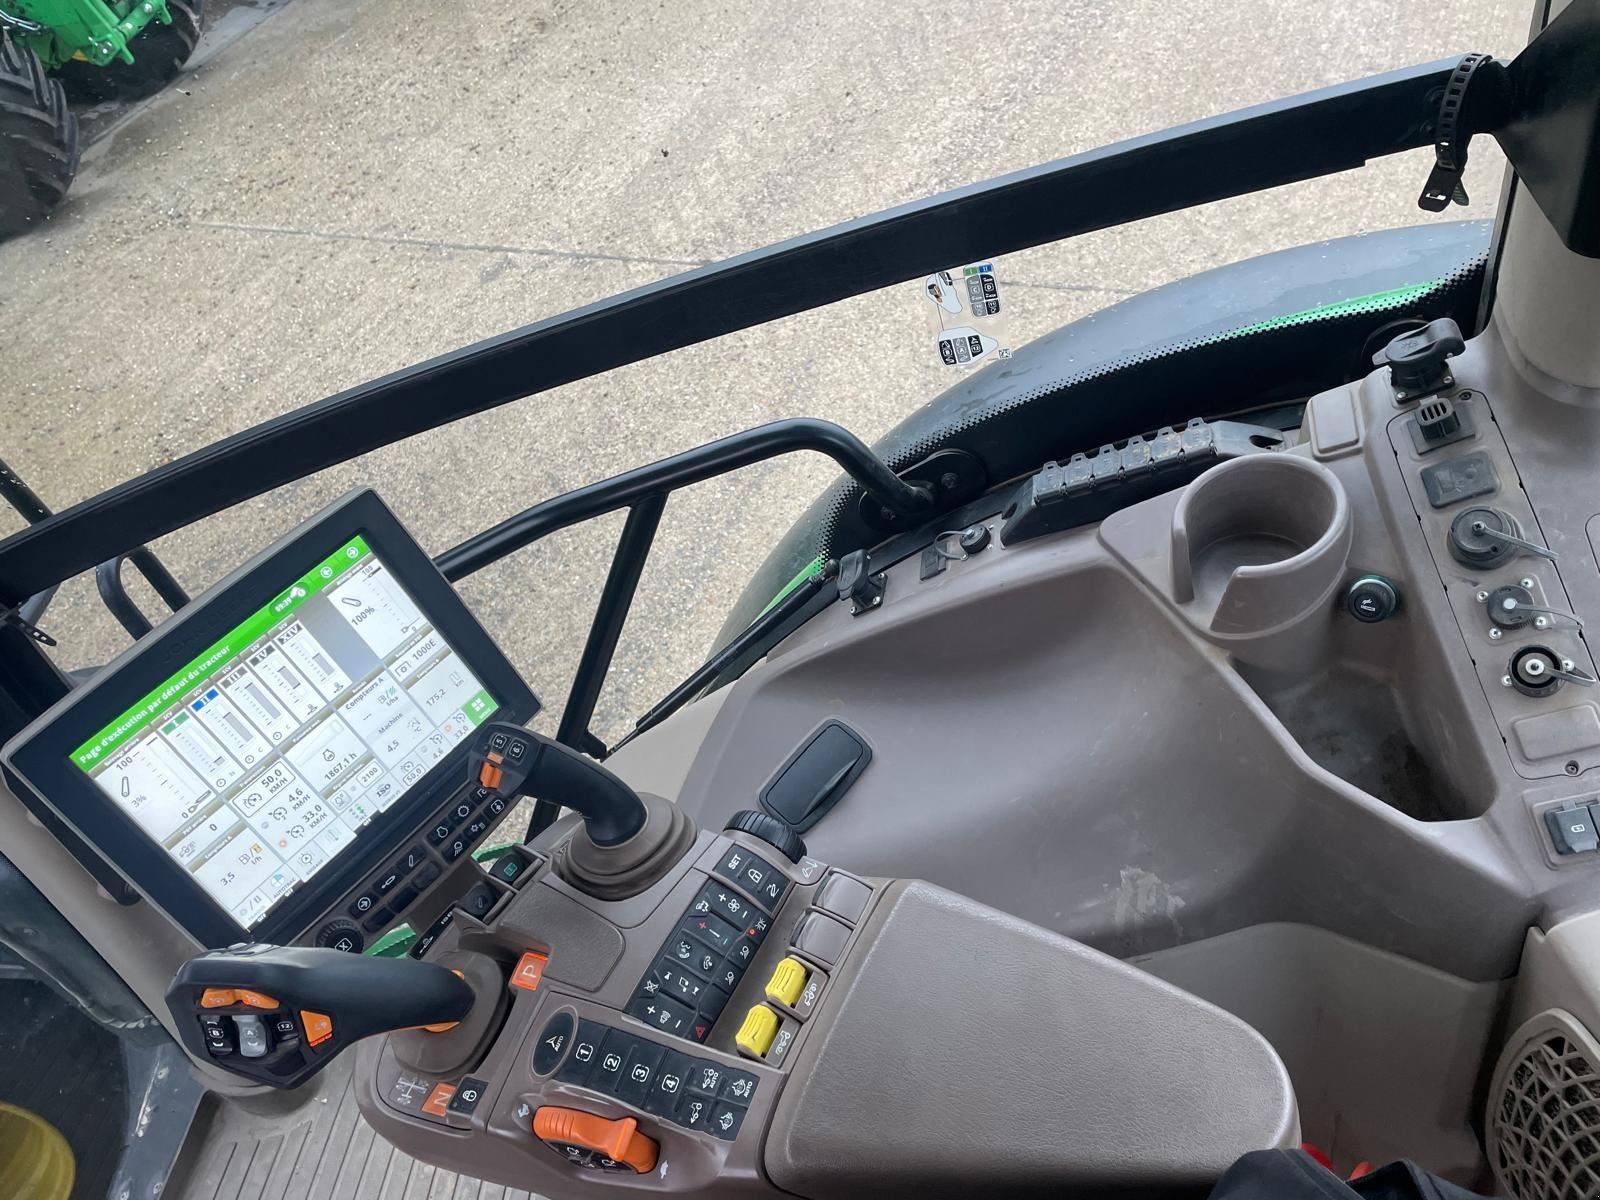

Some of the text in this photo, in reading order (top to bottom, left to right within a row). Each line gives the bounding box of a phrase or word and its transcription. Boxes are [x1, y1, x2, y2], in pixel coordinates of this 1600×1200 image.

[350, 604, 375, 626] 100%
[279, 624, 300, 642] XIV
[255, 649, 269, 661] IV
[411, 638, 436, 661] 1000E
[226, 670, 241, 684] III
[199, 694, 211, 705] II
[344, 681, 379, 710] Compteurs
[425, 688, 446, 707] 175,2
[78, 644, 231, 764] Page d'exécution par défaut du tracteur
[377, 711, 403, 734] Machine
[453, 724, 469, 739] 33,0
[385, 739, 400, 753] 4,5
[115, 755, 134, 771] 100
[324, 757, 350, 781] 1867,1
[348, 751, 357, 759] h
[260, 768, 283, 788] 50,0
[361, 766, 378, 782] 2100
[406, 767, 422, 783] 50,0
[268, 776, 288, 793] KM/H
[375, 782, 392, 797] ISO
[130, 793, 147, 808] 3%
[286, 787, 304, 803] 4,6
[291, 793, 311, 811] KM/H
[180, 811, 189, 819] 0
[301, 803, 323, 823] 33,0
[308, 811, 327, 829] KM/H
[208, 822, 218, 831] 0
[728, 853, 741, 870] SET
[219, 871, 237, 887] 3,5
[522, 964, 536, 978] P
[607, 1057, 619, 1067] 2
[635, 1068, 647, 1078] 3
[709, 1072, 719, 1089] AUTO
[665, 1079, 677, 1089] 4
[743, 1081, 753, 1098] AUTO
[433, 1091, 452, 1107] N
